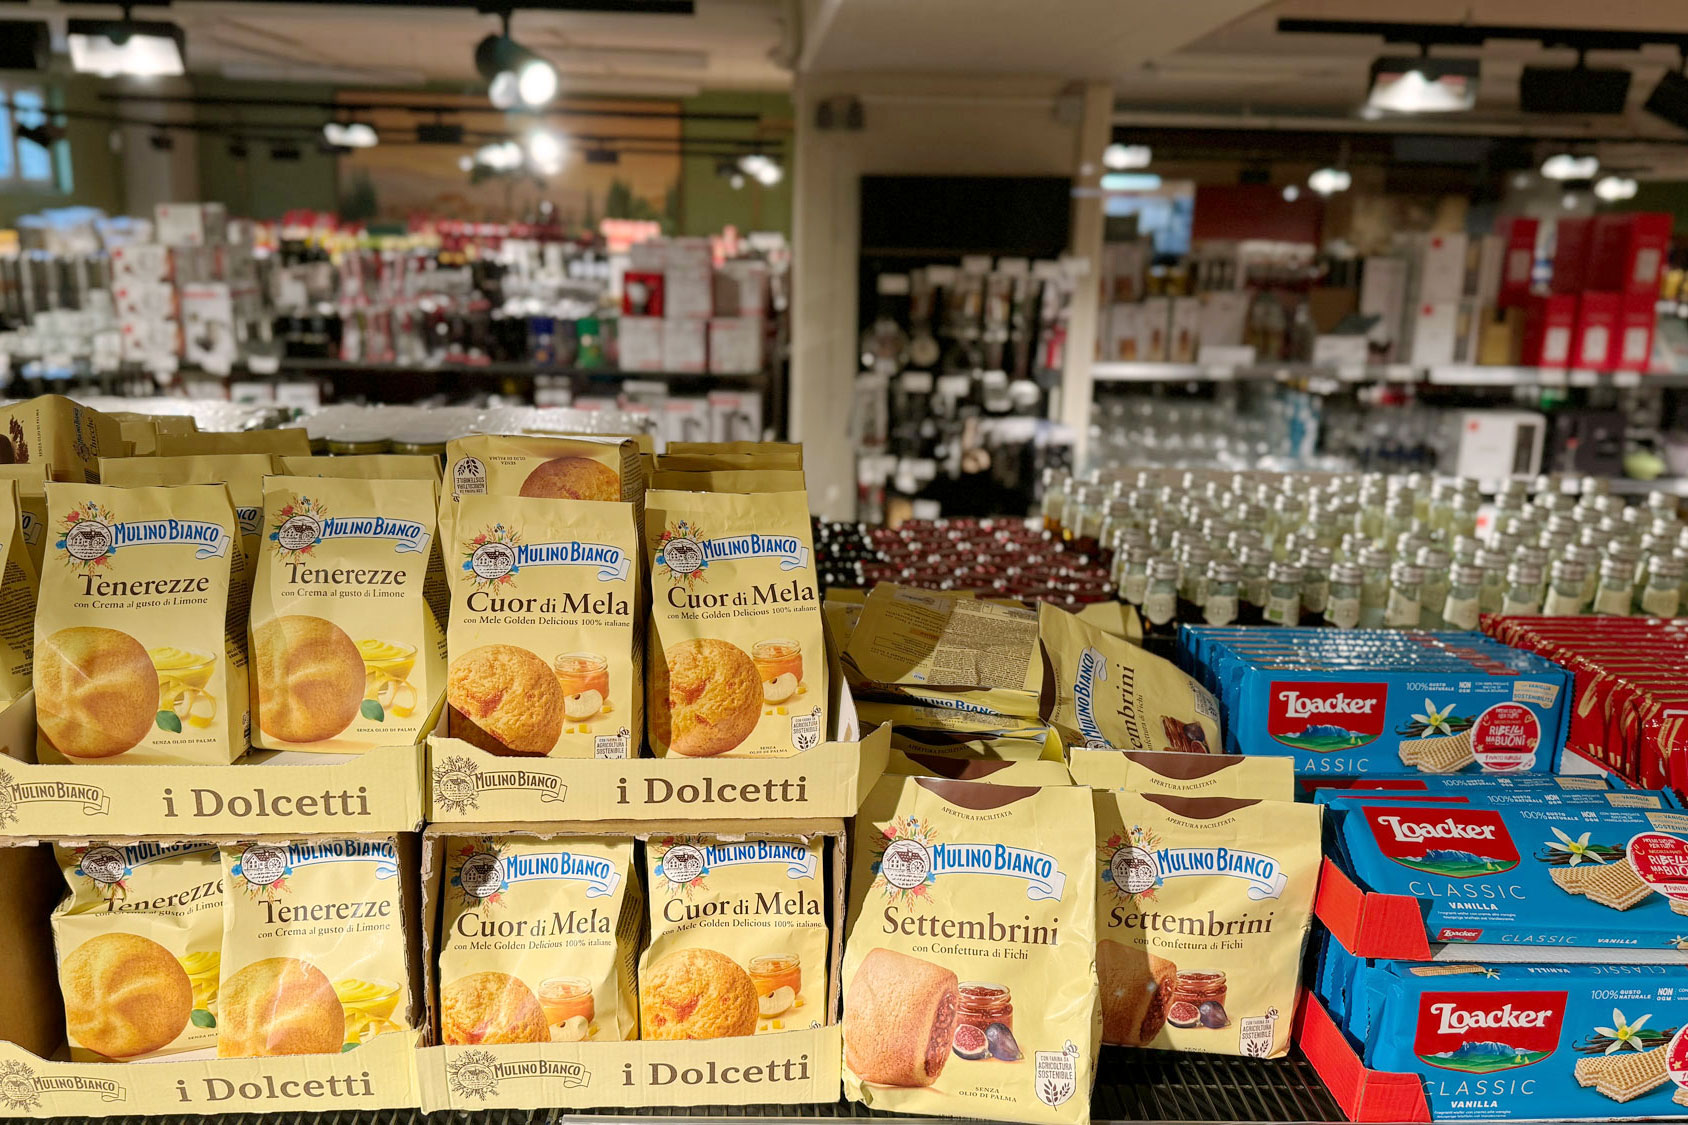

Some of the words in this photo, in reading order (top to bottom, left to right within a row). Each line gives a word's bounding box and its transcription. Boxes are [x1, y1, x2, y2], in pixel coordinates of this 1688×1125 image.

[114, 522, 166, 544] MULINO
[168, 519, 219, 542] BIANCO
[322, 518, 372, 537] MULINO
[373, 517, 420, 538] BIANCO
[518, 544, 568, 564] MULINO
[570, 541, 619, 564] BIANCO
[702, 540, 749, 558] MULINO
[751, 534, 797, 554] BIANCO
[285, 562, 406, 585] Tenerezze
[78, 574, 209, 596] Tenerezze
[297, 588, 327, 597] Crema
[330, 589, 337, 597] al
[339, 589, 362, 599] gusto
[373, 589, 405, 598] Limone
[668, 586, 729, 608] Cuor
[733, 592, 748, 606] di
[752, 580, 815, 606] Mela
[92, 600, 124, 608] Crema
[136, 599, 160, 609] gusto
[163, 598, 171, 606] di
[173, 597, 208, 605] Limone
[467, 592, 537, 613] Cuor
[540, 600, 556, 613] di
[562, 592, 629, 615] Mela
[479, 616, 501, 624] Mele
[504, 616, 536, 625] Golden
[539, 617, 578, 626] Delicious
[604, 619, 630, 627] italiane
[681, 612, 699, 620] Mele
[702, 610, 730, 619] Golden
[733, 609, 769, 617] Delicious
[1073, 653, 1094, 701] BIANCO
[1406, 682, 1428, 691] 100%
[1278, 691, 1376, 717] Loacker
[1078, 696, 1100, 739] MULINO
[1294, 758, 1369, 772] ASSIC
[475, 772, 516, 789] MULINO
[518, 771, 557, 789] BIANCO
[617, 778, 628, 804] i
[644, 776, 808, 804] Dolcetti
[1150, 778, 1181, 790] APERTURA
[1183, 779, 1217, 790] FACILITATA
[11, 783, 55, 801] MULINO
[56, 782, 99, 800] BIANCO
[1488, 795, 1513, 803] 100%
[163, 788, 178, 818] i
[191, 786, 372, 818] Dolcetti
[941, 806, 974, 820] APERTURA
[976, 810, 1012, 821] FACILITATA
[1166, 816, 1198, 829] APERTURA
[1200, 817, 1236, 829] FACILITATA
[1520, 811, 1547, 819] 100%
[1377, 815, 1496, 843] Loacker
[287, 843, 342, 865] MULINO
[345, 840, 396, 858] BIANCO
[706, 844, 755, 866] MULINO
[758, 840, 806, 861] BIANCO
[933, 843, 992, 870] MULINO
[995, 843, 1052, 878] BIANCO
[507, 854, 558, 880] MULINO
[561, 852, 610, 880] BIANCO
[1157, 849, 1213, 875] MULINO
[1217, 848, 1274, 879] BIANCO
[104, 879, 223, 912] Tenerezze
[1409, 881, 1526, 899] CLASSIC
[258, 899, 391, 924] Tenerezze
[664, 898, 730, 923] Cuor
[733, 899, 749, 914] di
[755, 890, 820, 916] Mela
[1449, 902, 1499, 910] VANILLA
[275, 928, 306, 937] Crema
[309, 927, 316, 935] al
[318, 927, 344, 936] gusto
[346, 924, 354, 933] di
[356, 923, 390, 932] Limone
[457, 912, 528, 938] Cuor
[530, 919, 546, 936] di
[549, 908, 610, 936] Mela
[662, 928, 674, 936] con
[676, 923, 697, 932] Mele
[699, 919, 730, 927] Golden
[732, 919, 771, 927] Delicious
[882, 906, 1058, 946] Settembrini
[1108, 906, 1275, 936] Settembrini
[470, 942, 491, 950] Mele
[494, 940, 526, 950] Golden
[528, 940, 562, 949] Delicious
[565, 939, 585, 947] 100%
[588, 938, 612, 946] italiane
[1134, 936, 1149, 944] con
[1152, 936, 1207, 950] Confettura
[1210, 941, 1218, 950] di
[1221, 939, 1243, 949] Fichi
[1501, 934, 1577, 944] CLASSIC
[931, 943, 989, 957] Confettura
[992, 949, 1001, 958] di
[1004, 948, 1028, 960] Fichi
[1590, 966, 1666, 974] CLASSIC
[1591, 990, 1618, 999] 100%
[1430, 1002, 1552, 1034] Loacker
[494, 1063, 537, 1078] MULINO
[539, 1060, 580, 1076] BIANCO
[622, 1062, 635, 1086] i
[648, 1054, 811, 1086] Dolcetti
[1038, 1062, 1072, 1070] AGRICOLTURA
[1038, 1070, 1073, 1080] SOSTENIBILE
[32, 1077, 74, 1091] MULINO
[74, 1076, 115, 1091] BIANCO
[176, 1079, 192, 1102] i
[204, 1071, 375, 1101] Dolcetti
[1422, 1080, 1536, 1096] CLASSIC
